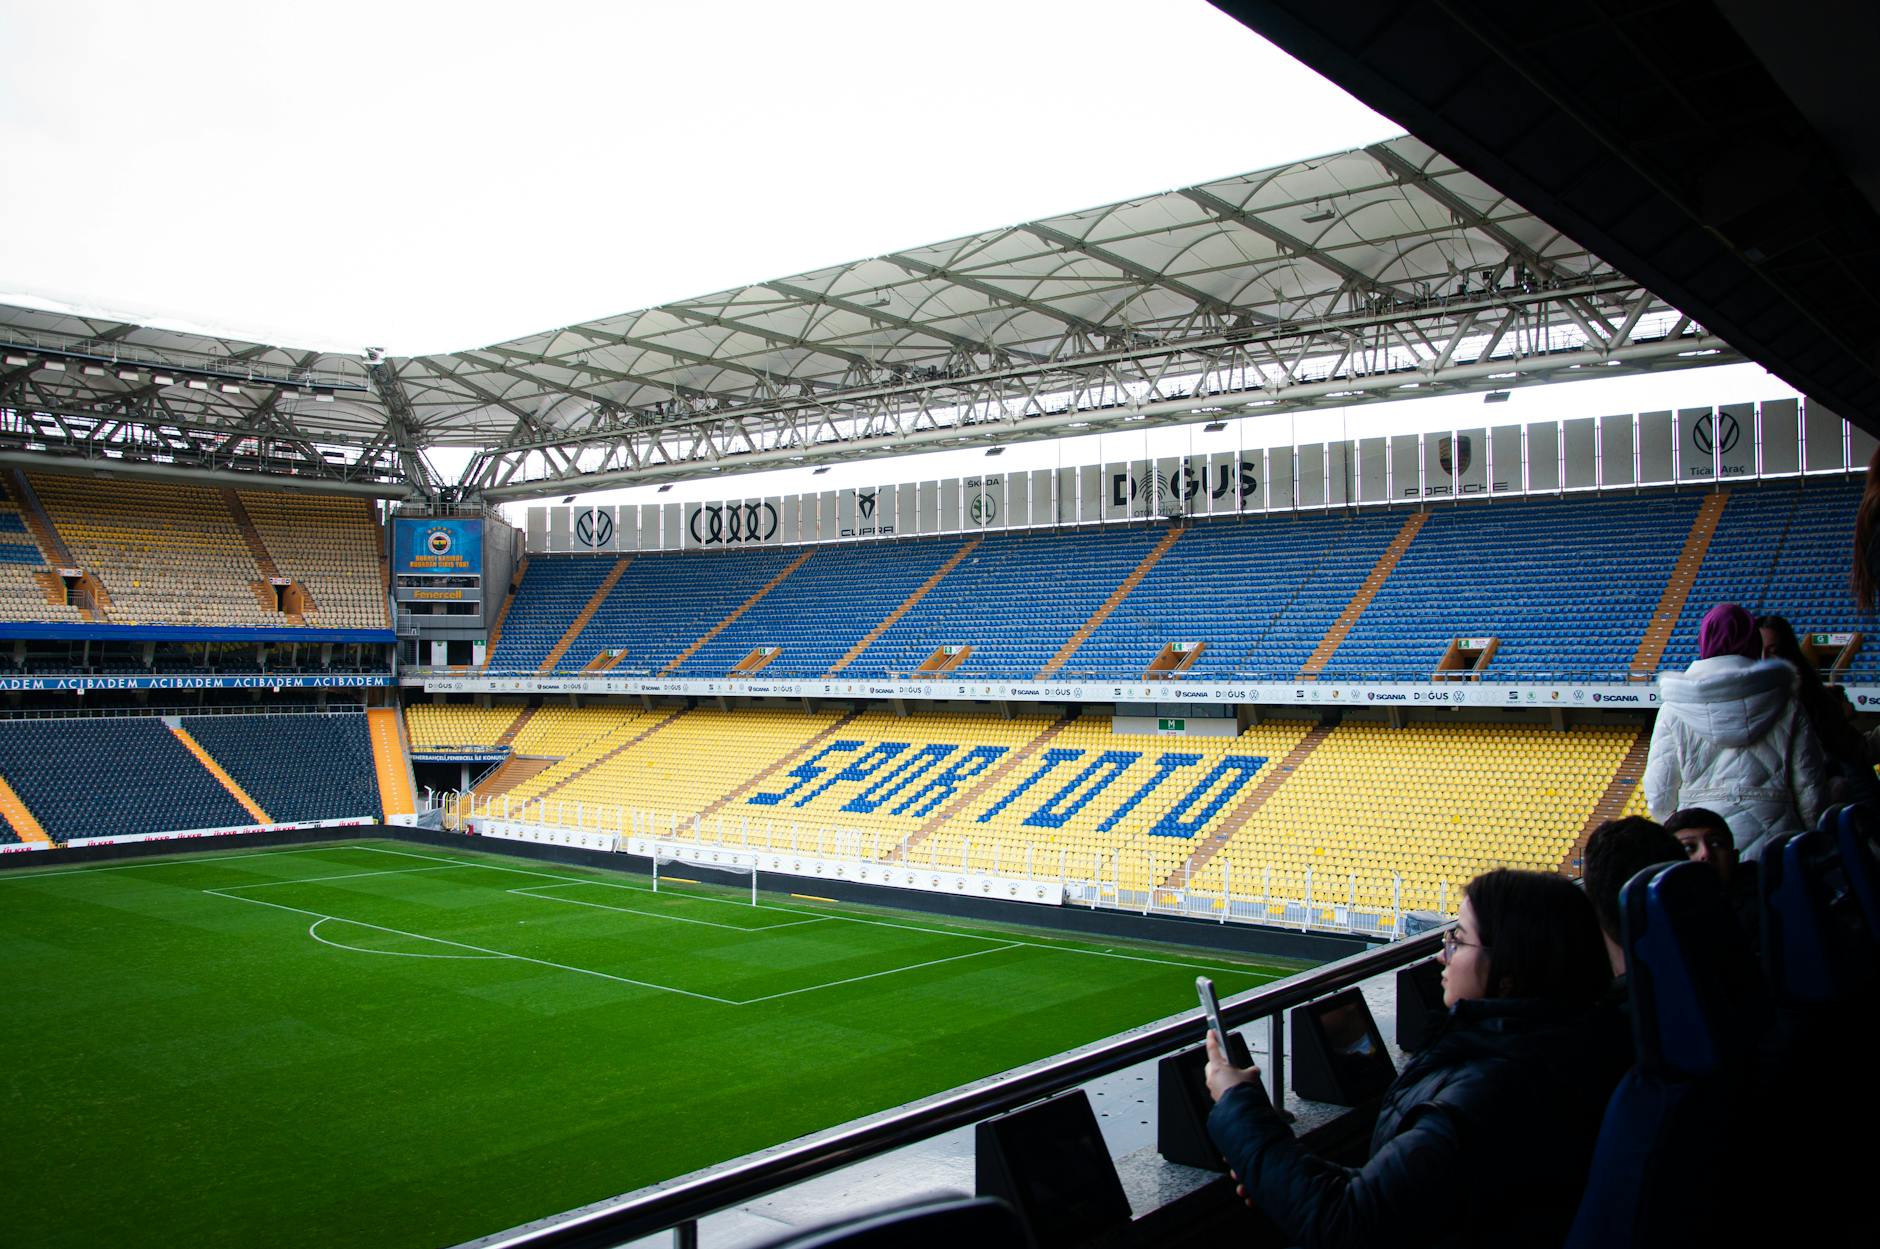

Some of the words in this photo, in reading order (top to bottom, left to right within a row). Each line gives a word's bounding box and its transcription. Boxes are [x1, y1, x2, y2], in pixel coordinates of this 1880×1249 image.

[967, 478, 999, 488] ŠKDA
[1404, 481, 1508, 497] PORSCHE
[841, 526, 893, 537] CUPRA
[57, 679, 138, 689] ACIBADEM
[149, 678, 224, 689] ACIBADEM
[233, 678, 304, 688] ACIBADEM
[313, 676, 384, 687] ACIBADEM
[745, 739, 1010, 818] SPOR
[976, 748, 1269, 839] TOTO
